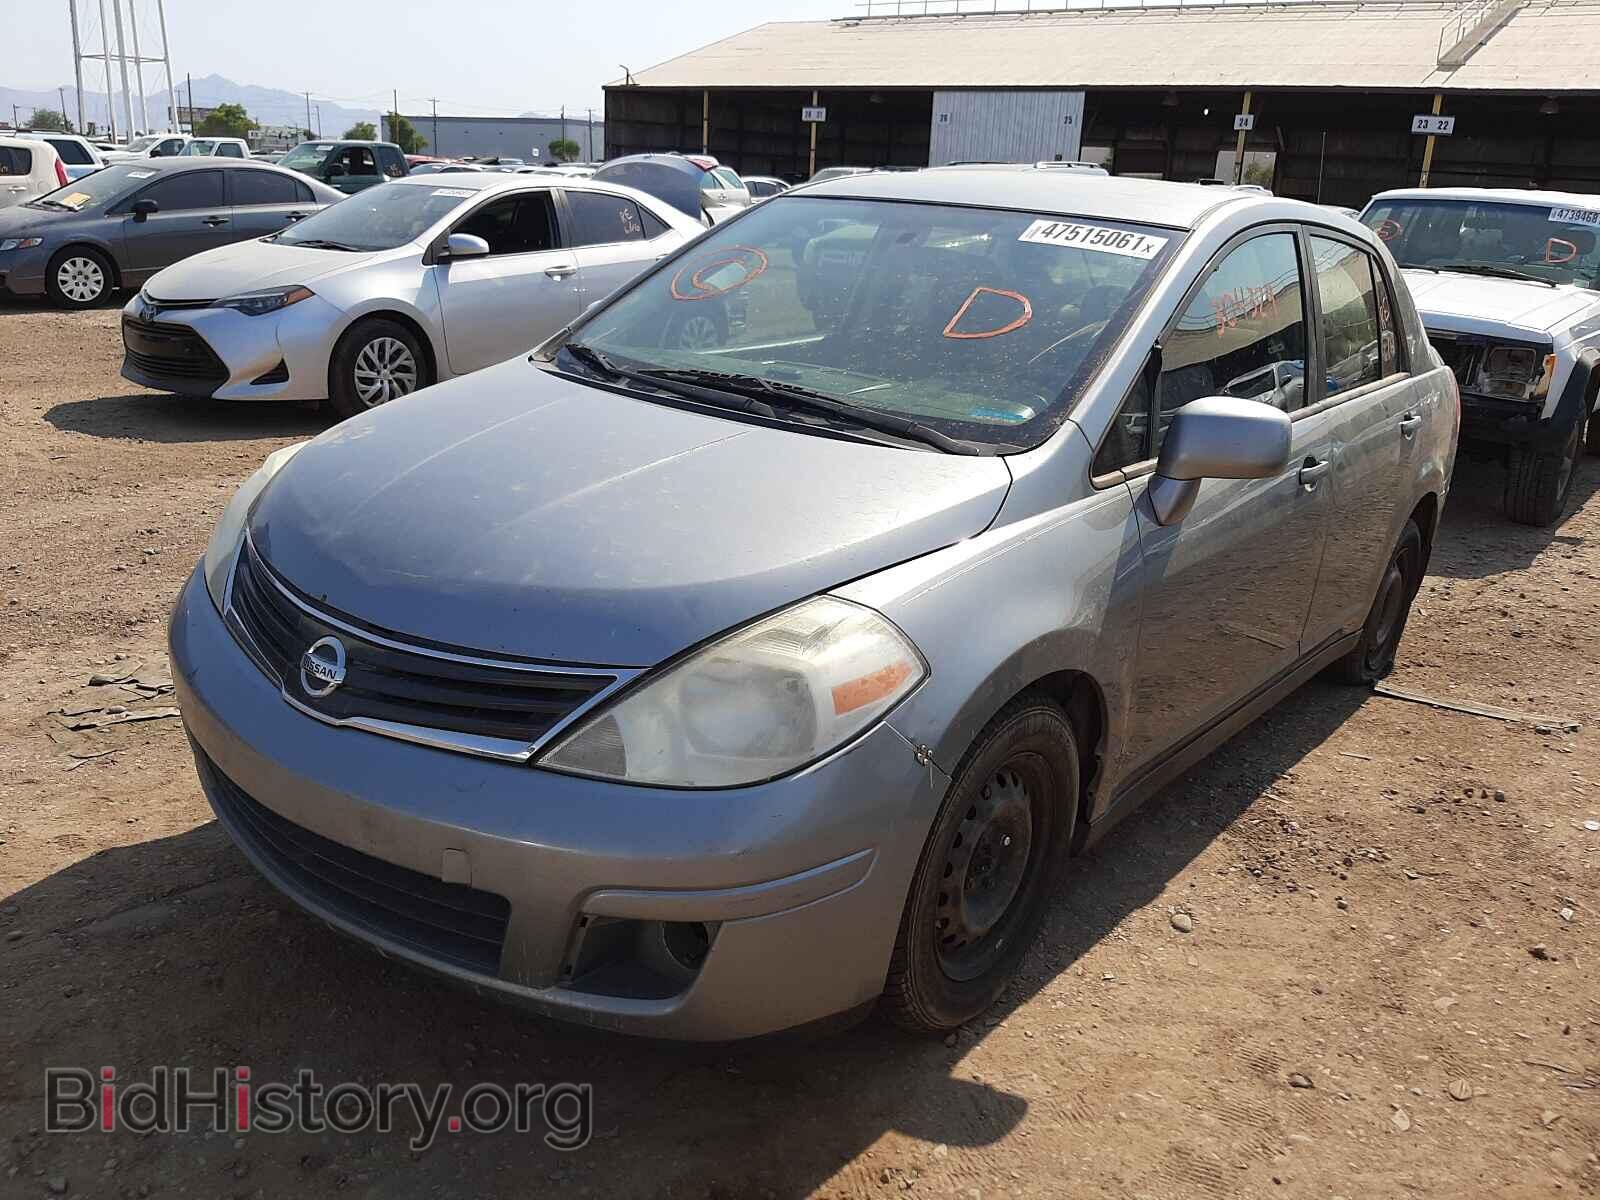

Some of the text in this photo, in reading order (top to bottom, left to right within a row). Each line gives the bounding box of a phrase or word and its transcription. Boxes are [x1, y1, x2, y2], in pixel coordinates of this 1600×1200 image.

[1239, 117, 1248, 127] 24
[1417, 119, 1449, 130] 23 22
[1544, 237, 1577, 263] D
[942, 287, 1033, 339] D
[303, 653, 337, 680] NISSAN
